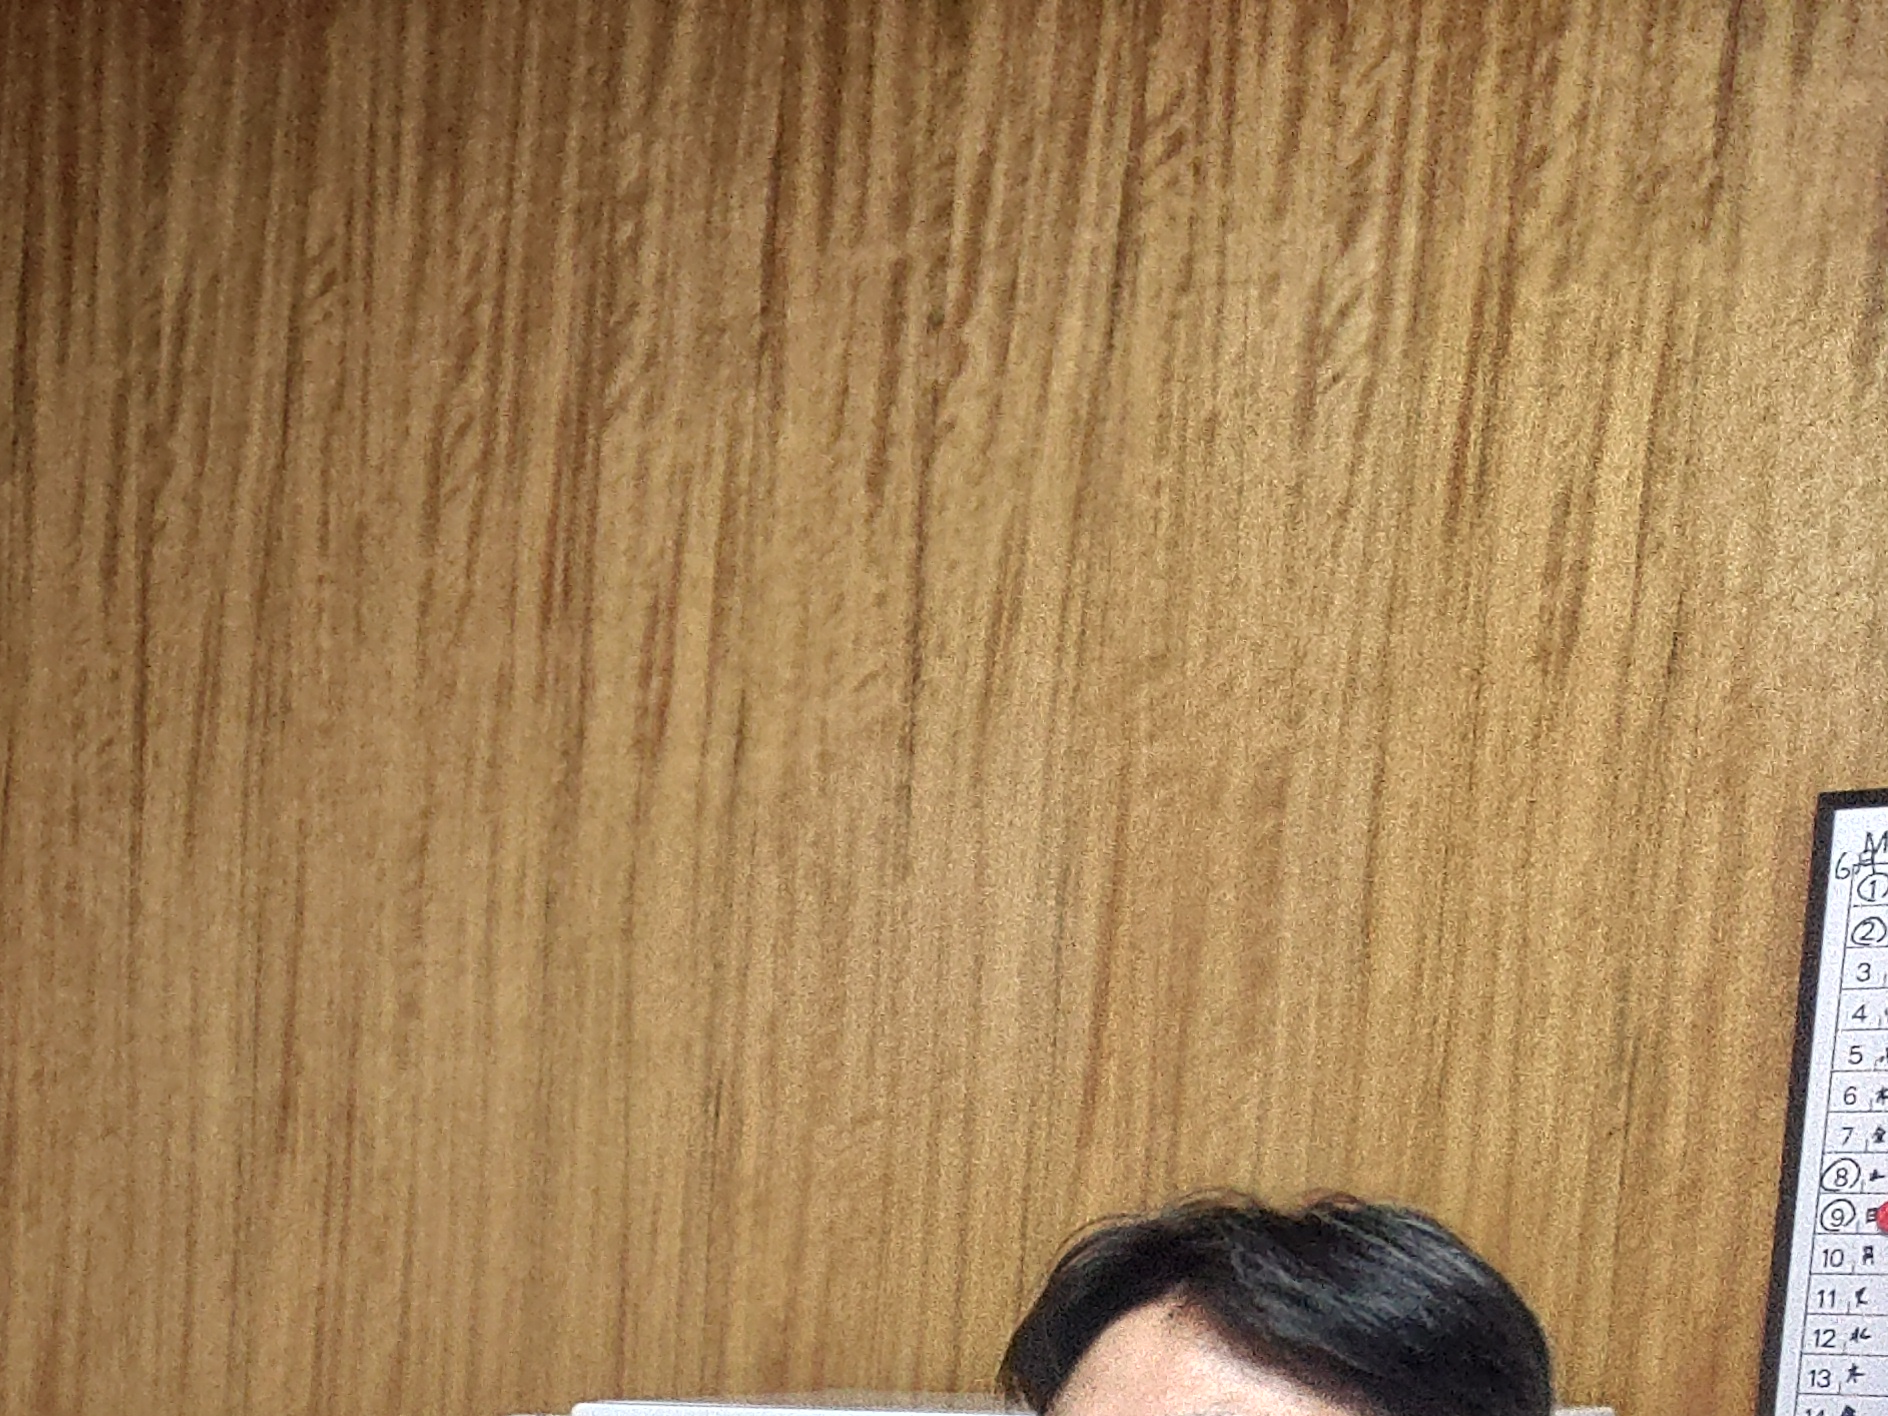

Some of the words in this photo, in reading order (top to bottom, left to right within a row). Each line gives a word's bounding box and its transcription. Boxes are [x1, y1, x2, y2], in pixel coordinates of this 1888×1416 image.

[1870, 880, 1876, 898] 1
[1861, 920, 1875, 941] 2
[1856, 963, 1871, 982] 3
[1852, 1004, 1868, 1022] 4
[1848, 1045, 1863, 1064] 5
[1844, 1086, 1857, 1105] 6
[1842, 1127, 1855, 1145] 7
[1834, 1168, 1849, 1187] 8
[1831, 1208, 1845, 1227] 9
[1822, 1248, 1844, 1268] 10
[1817, 1289, 1835, 1308] 11
[1814, 1329, 1836, 1348] 12
[1810, 1369, 1831, 1388] 13
